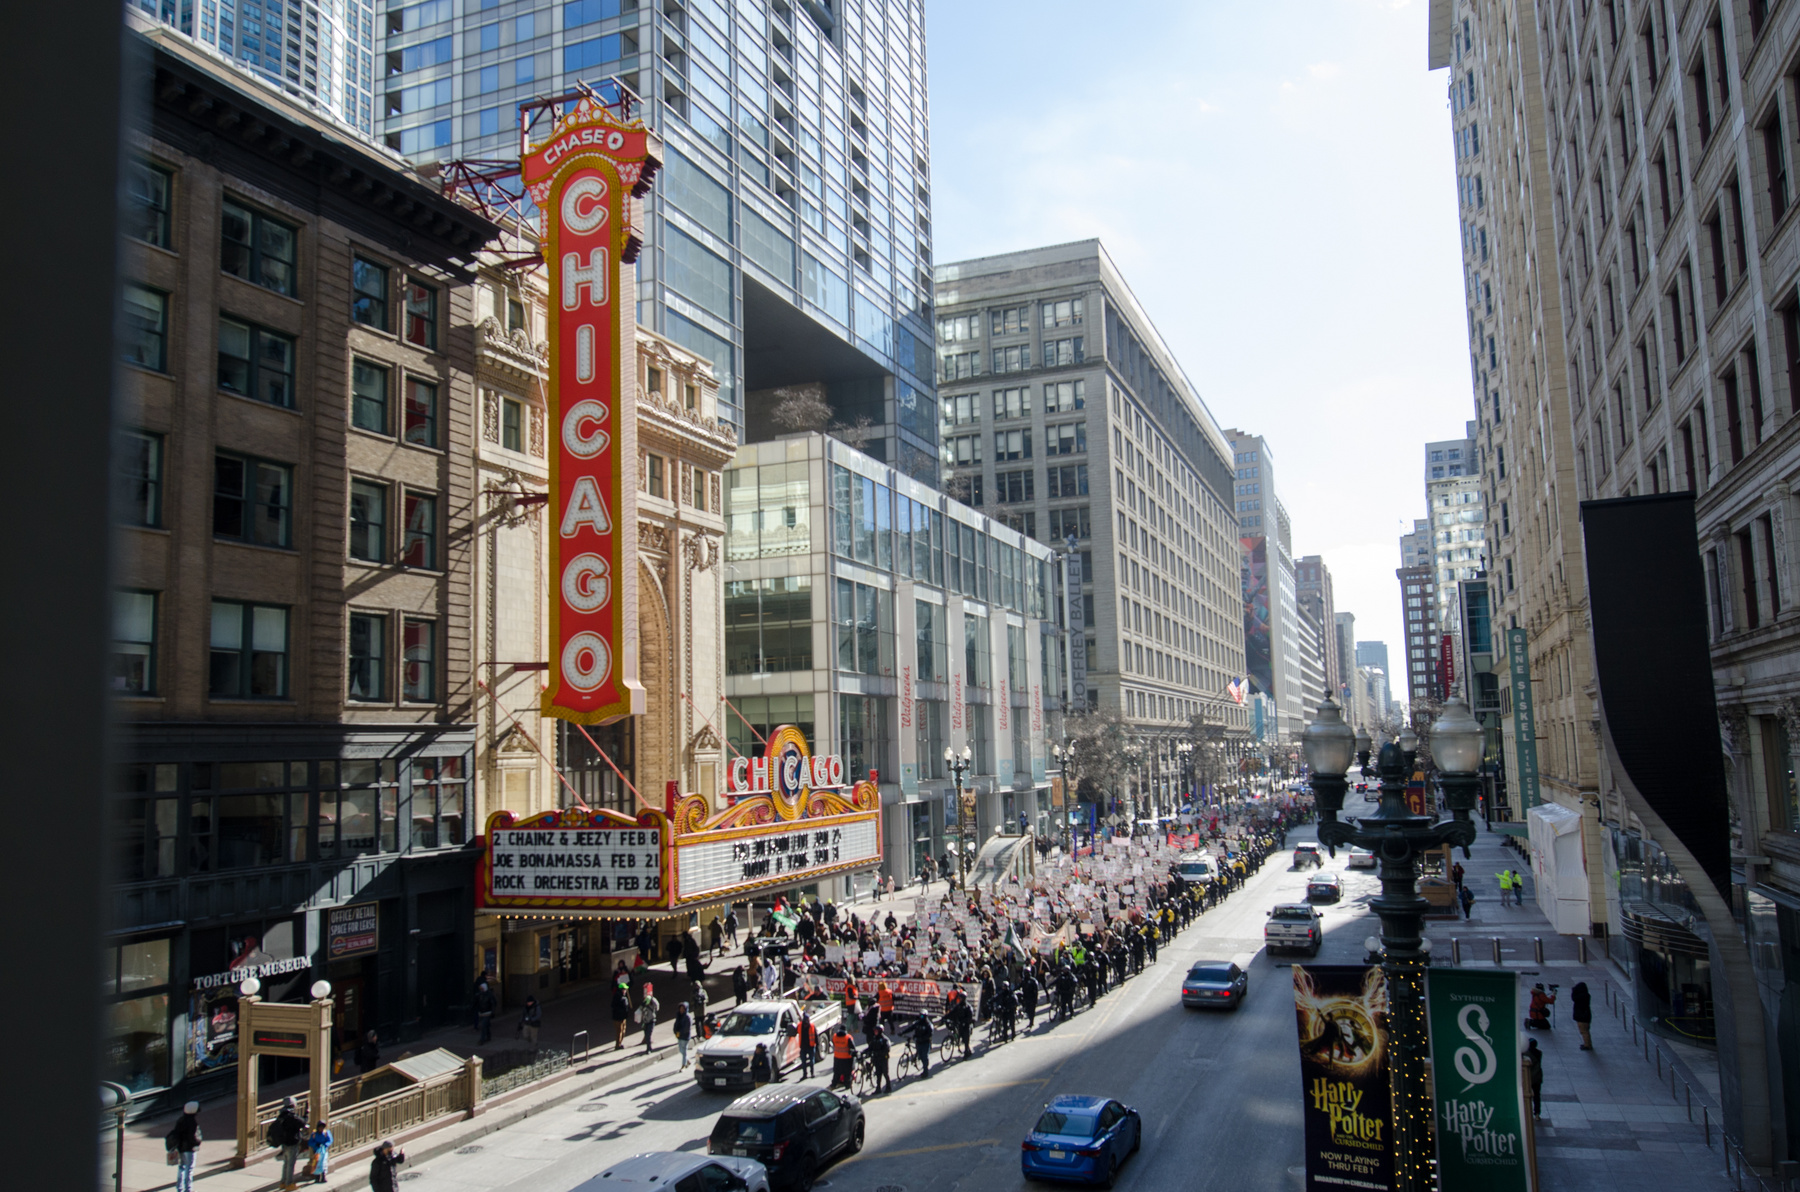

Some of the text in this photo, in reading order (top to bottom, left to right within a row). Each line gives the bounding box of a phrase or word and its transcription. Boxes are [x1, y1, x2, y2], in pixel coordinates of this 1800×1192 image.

[543, 129, 605, 165] CHASE
[560, 176, 613, 693] CHICAGO
[1068, 556, 1087, 706] JOFFREY BALLET
[901, 665, 914, 729] Walgreens
[952, 672, 963, 730] Walgreens
[1000, 678, 1010, 731] Walgreens
[1033, 684, 1043, 732] Walgreens
[1513, 634, 1534, 808] GENE SISKEL FILM CENTE
[732, 754, 844, 792] CHICAGO
[493, 831, 658, 846] 2 CHAINZ & JEEZY FEB 8
[493, 853, 658, 868] JOE BONAMASSA FEB 21
[494, 875, 660, 890] ROCK ORCHESTRA FEB 28
[330, 918, 376, 936] SPACE FOR LEASE
[331, 905, 376, 923] OFFICE/RETAIL
[194, 955, 313, 990] TORTURE MUSEUM
[828, 981, 845, 991] STOP
[868, 982, 899, 992] TRMP
[904, 983, 936, 993] AGENDA
[1310, 1077, 1363, 1112] Harry
[1328, 1103, 1384, 1142] Potter
[1441, 1099, 1495, 1133] Harry
[1335, 1138, 1384, 1151] CURSED CHILD
[1460, 1123, 1516, 1159] Potter
[1320, 1151, 1380, 1167] NOW PLAYING
[1328, 1161, 1374, 1175] THRU FEB 1
